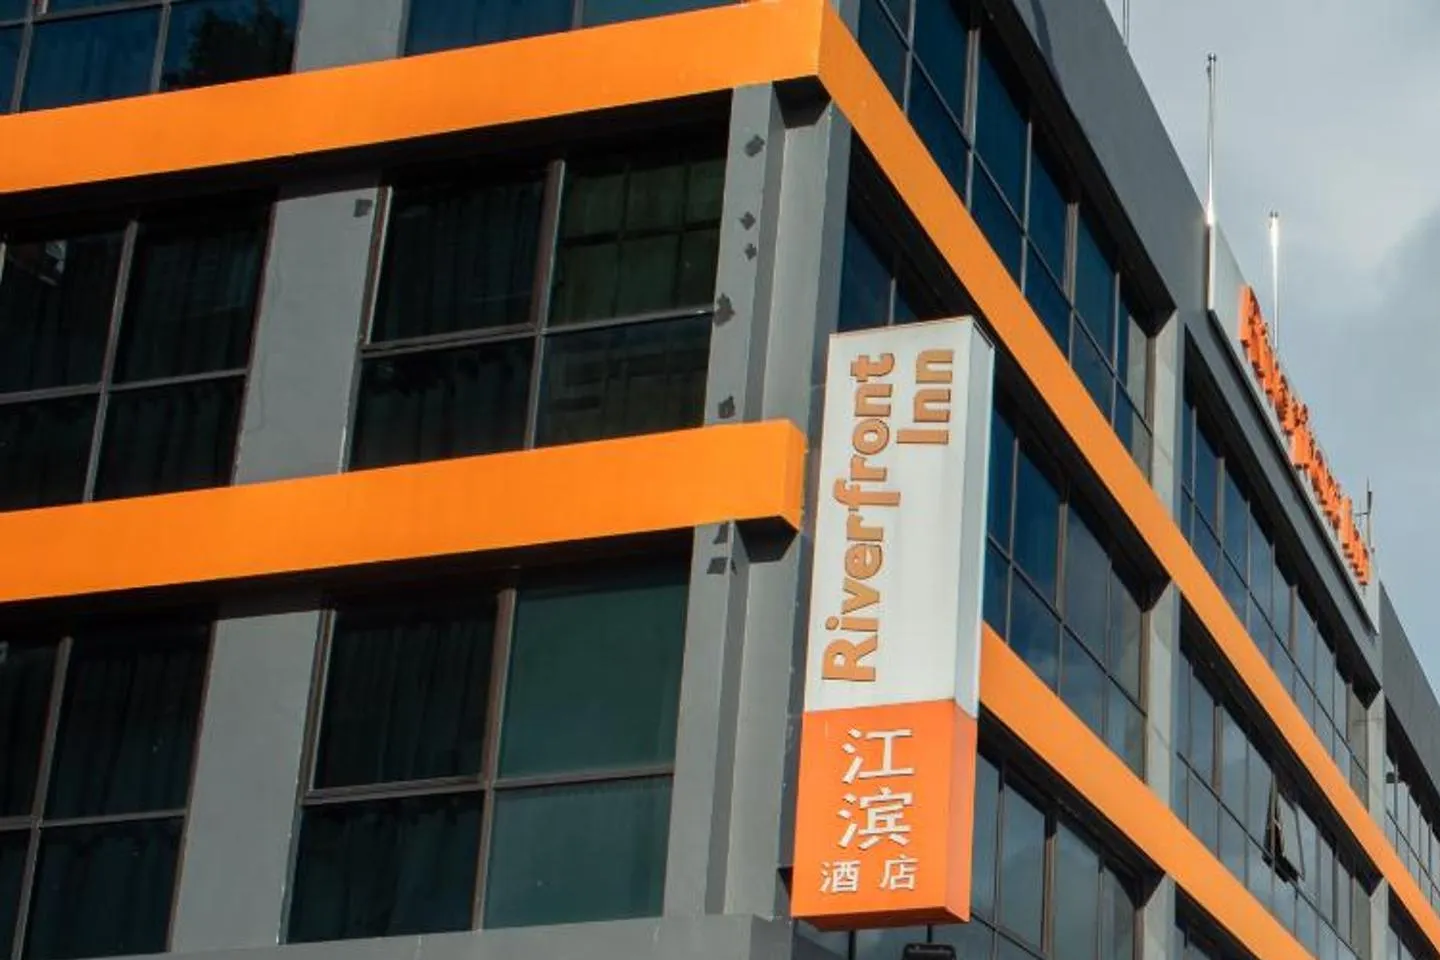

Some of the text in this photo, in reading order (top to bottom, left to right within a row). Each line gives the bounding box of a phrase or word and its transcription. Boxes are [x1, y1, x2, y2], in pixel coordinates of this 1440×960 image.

[897, 349, 954, 445] Inn
[822, 352, 901, 681] Riverfront
[837, 728, 914, 849] 江滨
[820, 854, 918, 893] 酒店
